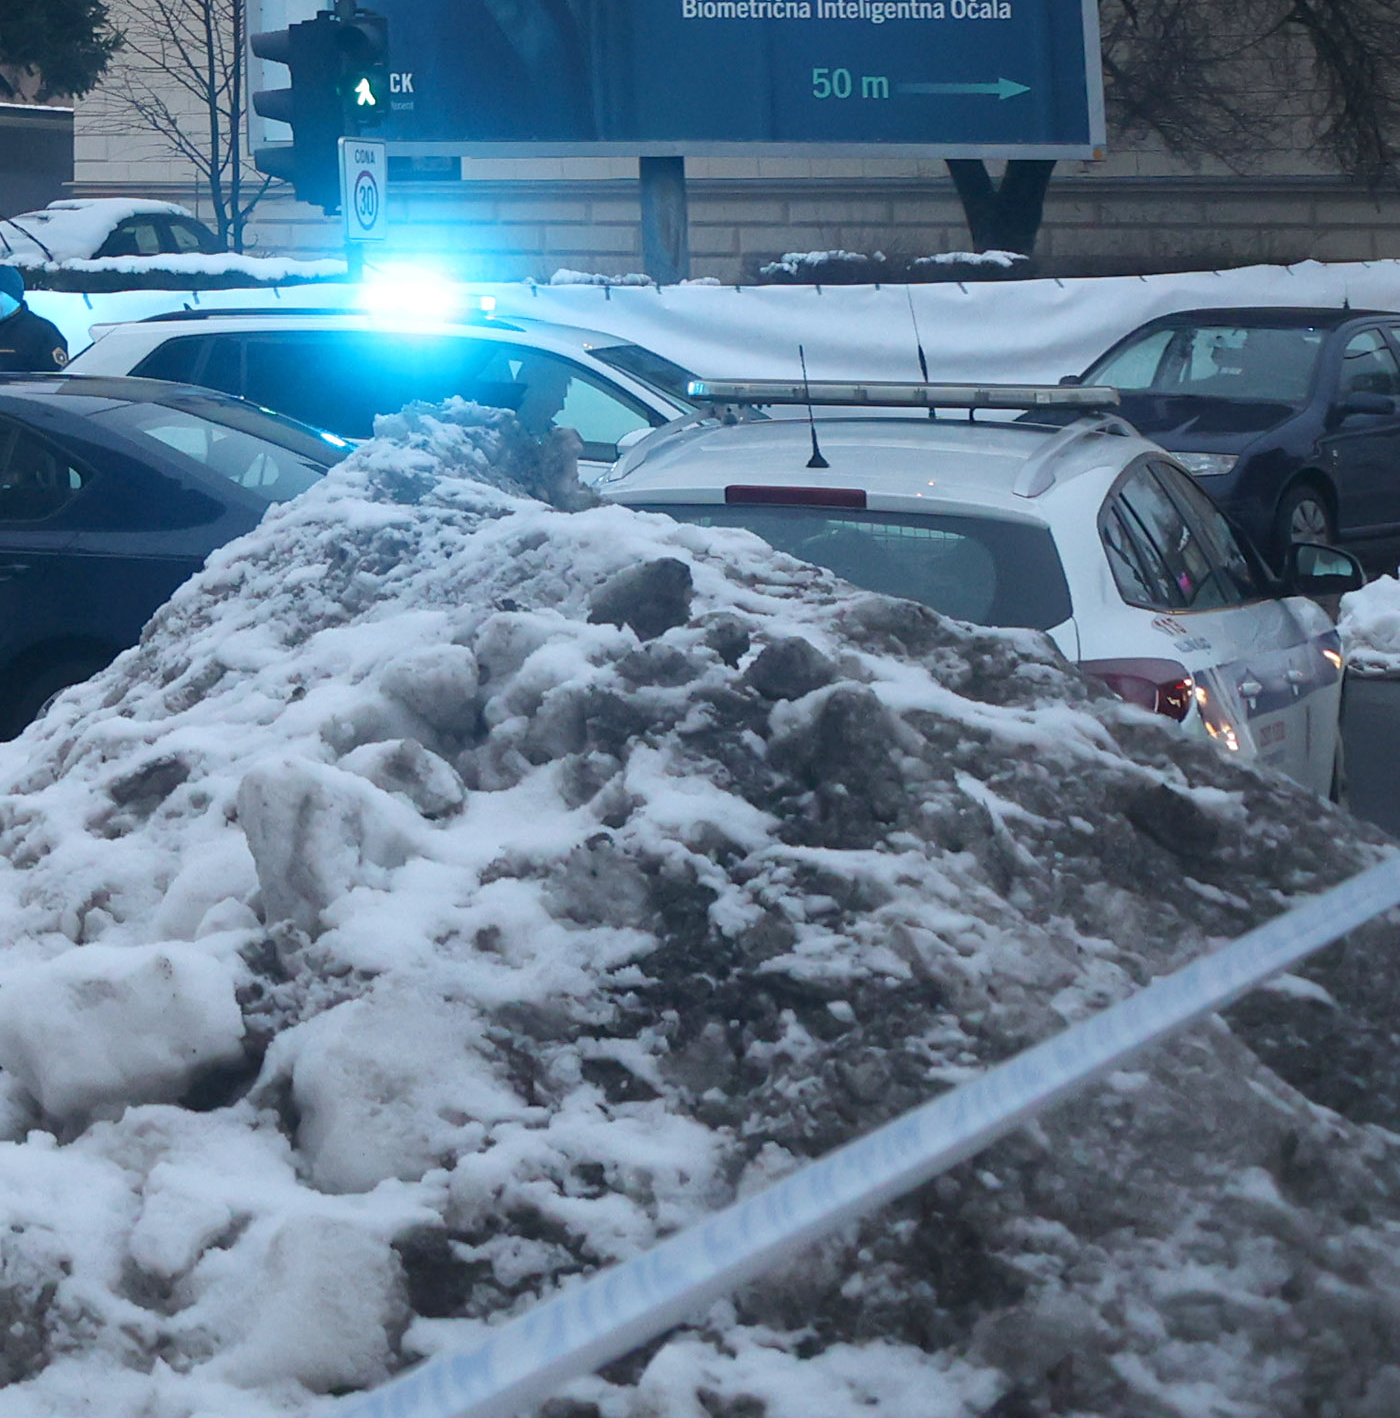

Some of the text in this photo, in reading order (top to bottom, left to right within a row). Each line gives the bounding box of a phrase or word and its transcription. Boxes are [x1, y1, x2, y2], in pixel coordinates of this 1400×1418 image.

[812, 68, 890, 99] 50 m
[354, 149, 376, 164] CONA
[360, 185, 375, 216] 30
